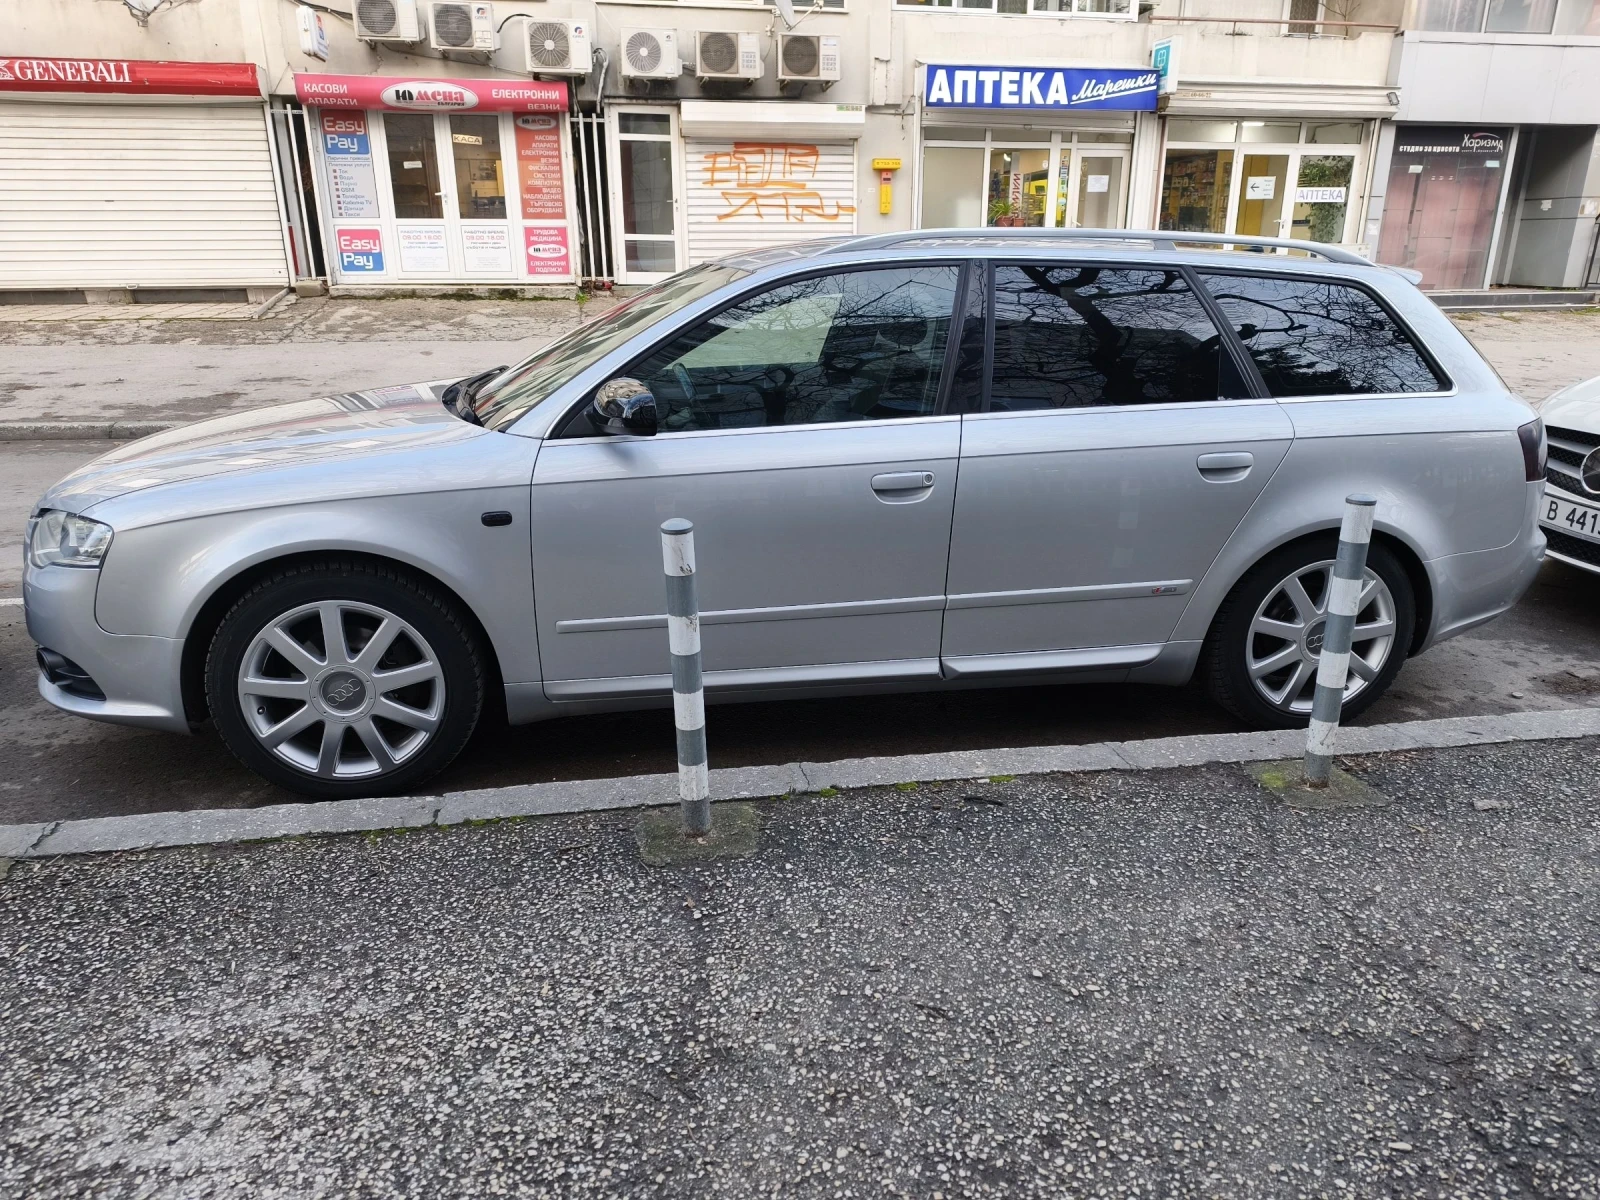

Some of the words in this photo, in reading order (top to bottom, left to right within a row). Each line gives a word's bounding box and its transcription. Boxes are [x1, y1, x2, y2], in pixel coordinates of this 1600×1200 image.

[14, 60, 132, 82] GENERALI
[304, 83, 348, 94] КАСОВИ
[492, 89, 559, 100] ЕЛЕКТРОННИ
[928, 69, 1069, 104] АПТЕКА
[1071, 73, 1157, 100] Марешки
[308, 97, 358, 106] АПАРАТИ
[323, 117, 365, 135] Easy
[326, 134, 358, 152] Pay
[453, 135, 480, 143] КАСА
[1299, 189, 1344, 200] АПТЕКА
[340, 236, 381, 253] Easy
[342, 253, 373, 269] Pay
[1547, 500, 1558, 521] B
[1565, 507, 1600, 536] 441
